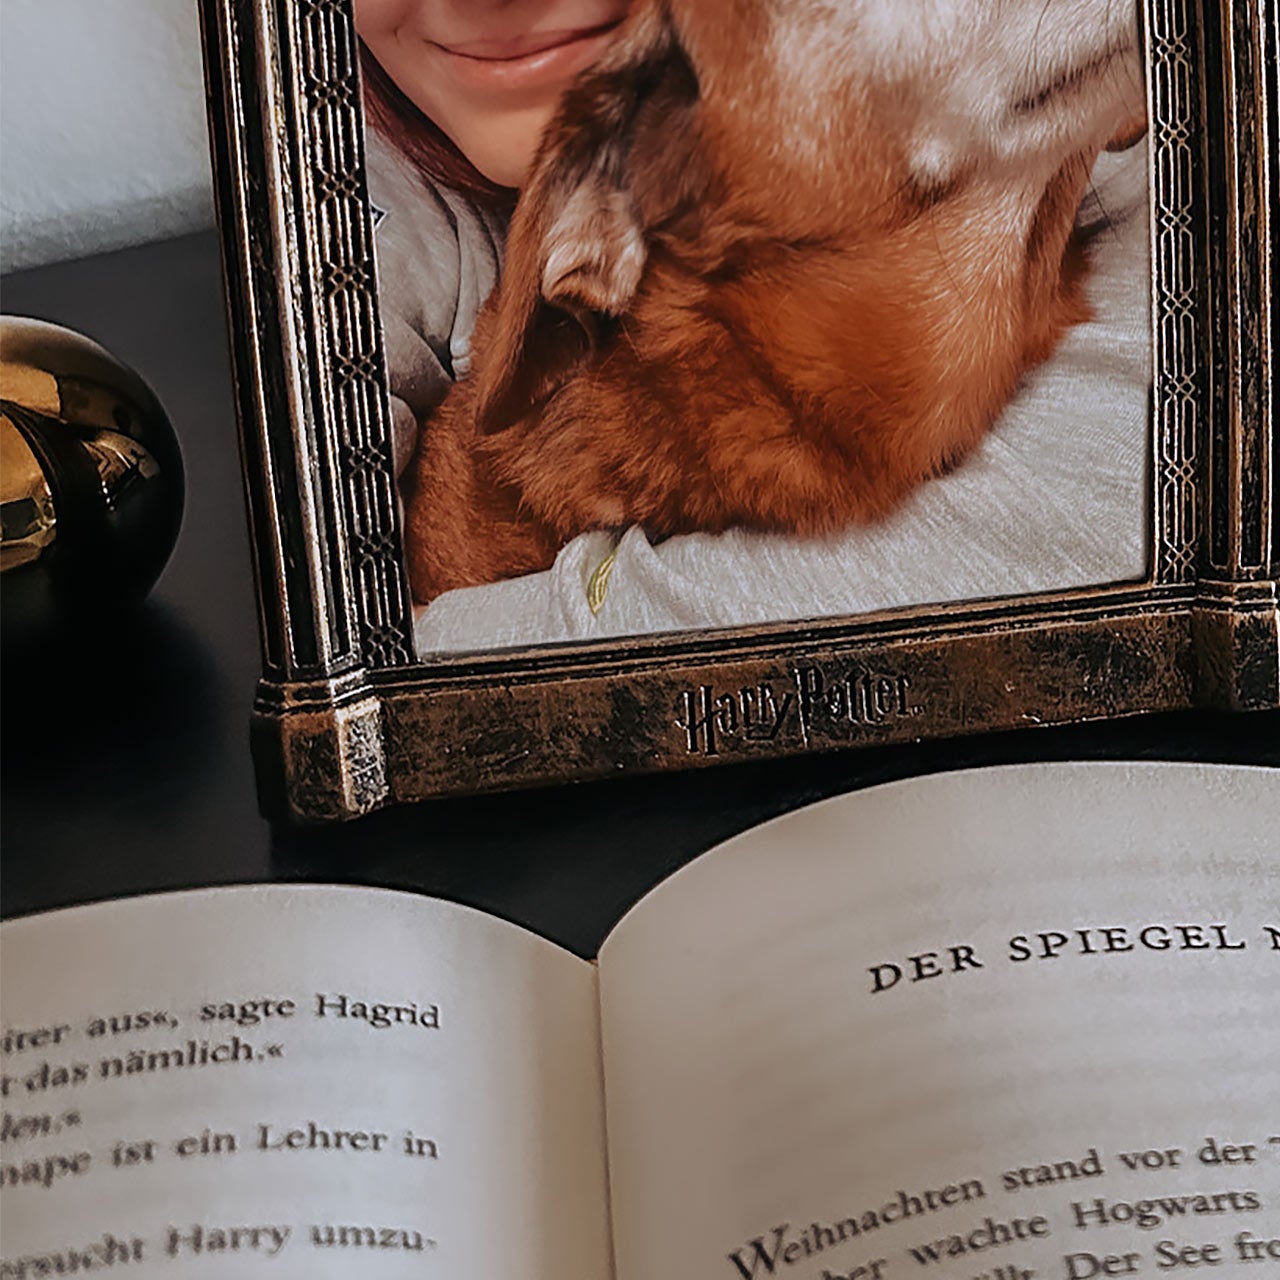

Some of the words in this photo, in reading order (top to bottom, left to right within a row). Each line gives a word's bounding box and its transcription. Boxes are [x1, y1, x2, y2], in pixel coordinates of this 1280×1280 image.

[675, 684, 793, 757] Harry
[793, 665, 912, 749] Potter
[869, 945, 984, 994] DER
[1008, 925, 1246, 963] SPIEGEL
[200, 996, 297, 1026] sagte
[315, 993, 441, 1030] Hagrid
[25, 1061, 90, 1092] das
[100, 1036, 285, 1080] nämlich.«
[112, 1138, 157, 1169] ist
[176, 1127, 238, 1159] ein
[258, 1120, 389, 1153] Lehrer
[403, 1129, 440, 1161] in
[728, 1176, 987, 1280] Weihnachten
[1002, 1148, 1104, 1193] stand
[1118, 1145, 1183, 1173] vor
[1199, 1138, 1257, 1166] der
[908, 1216, 1053, 1267] wachte
[1072, 1188, 1261, 1230] Hogwarts
[166, 1222, 292, 1257] Harry
[309, 1222, 439, 1252] umzu-
[1062, 1250, 1141, 1280] Der
[1156, 1238, 1223, 1269] See
